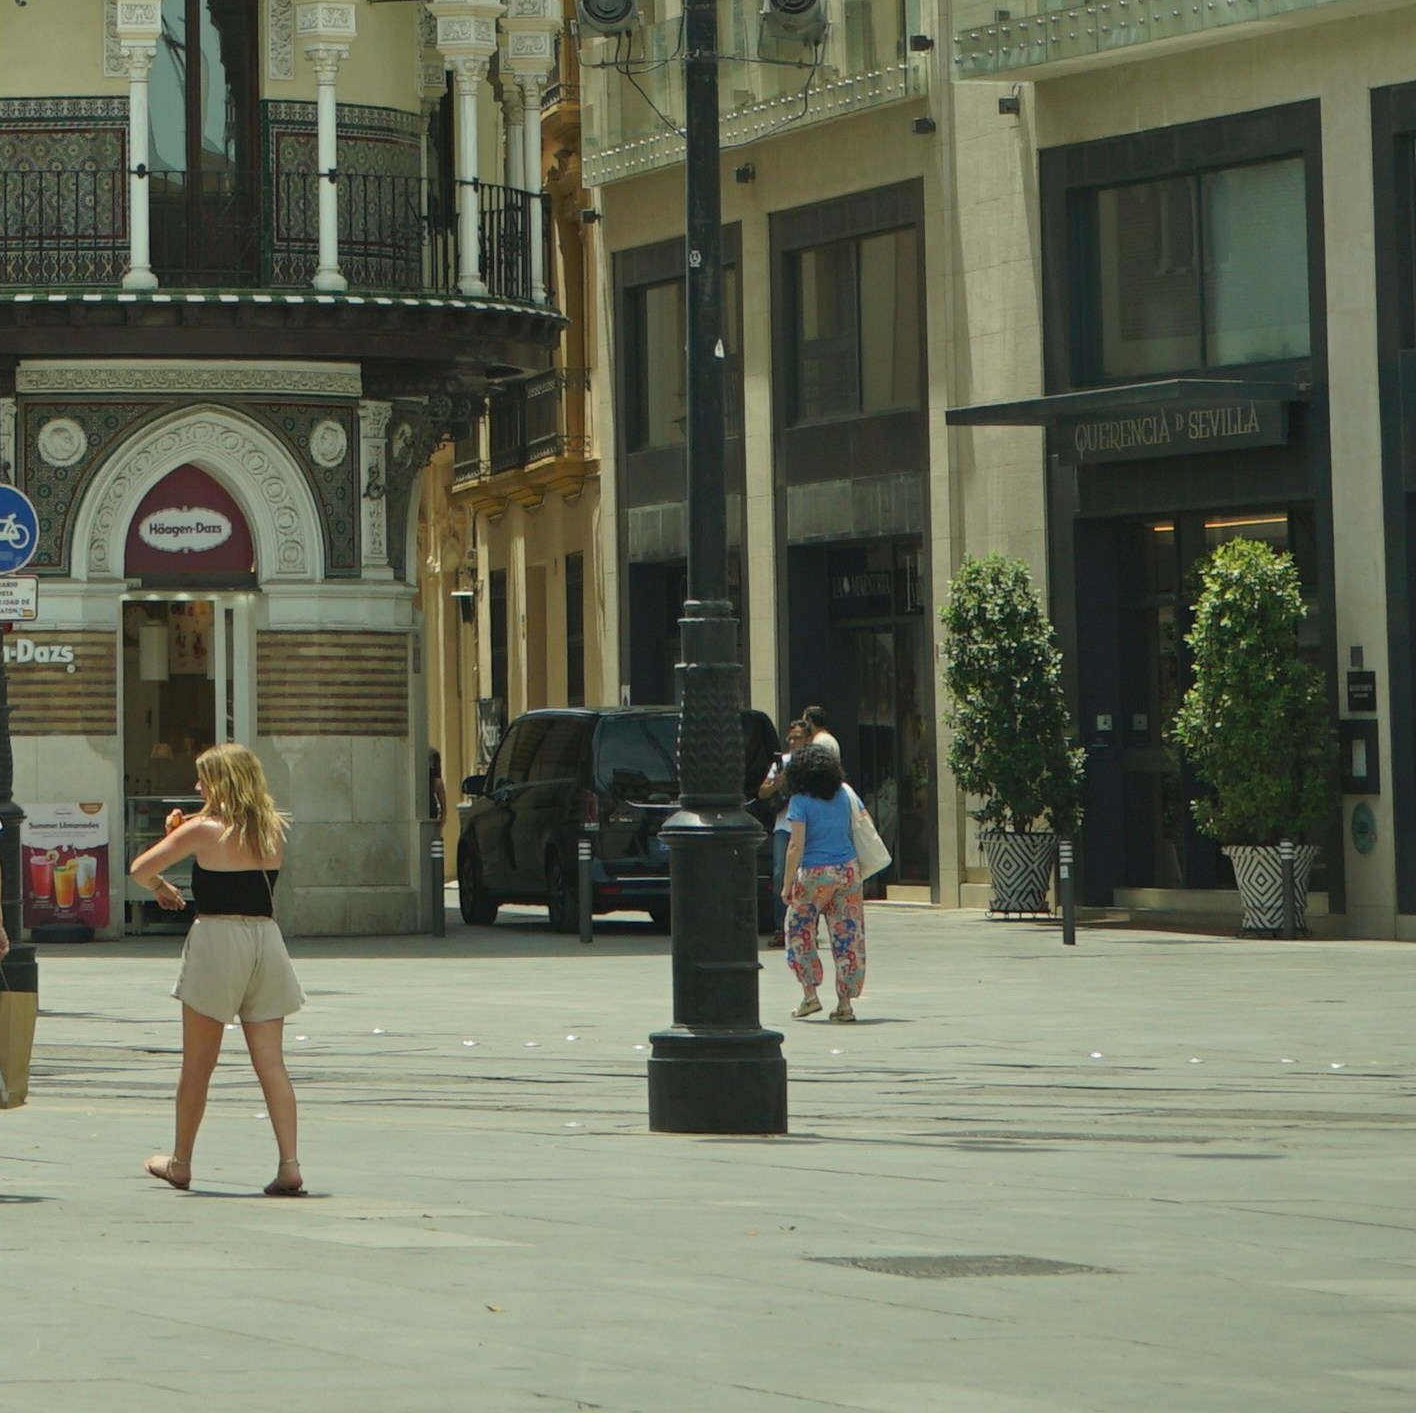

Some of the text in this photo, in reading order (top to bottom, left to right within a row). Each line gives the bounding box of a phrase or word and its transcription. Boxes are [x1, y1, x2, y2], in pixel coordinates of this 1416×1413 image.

[1074, 407, 1171, 461] QUERENCIA
[1188, 400, 1260, 440] SEVILLA
[149, 522, 222, 538] Häagen-Dazs
